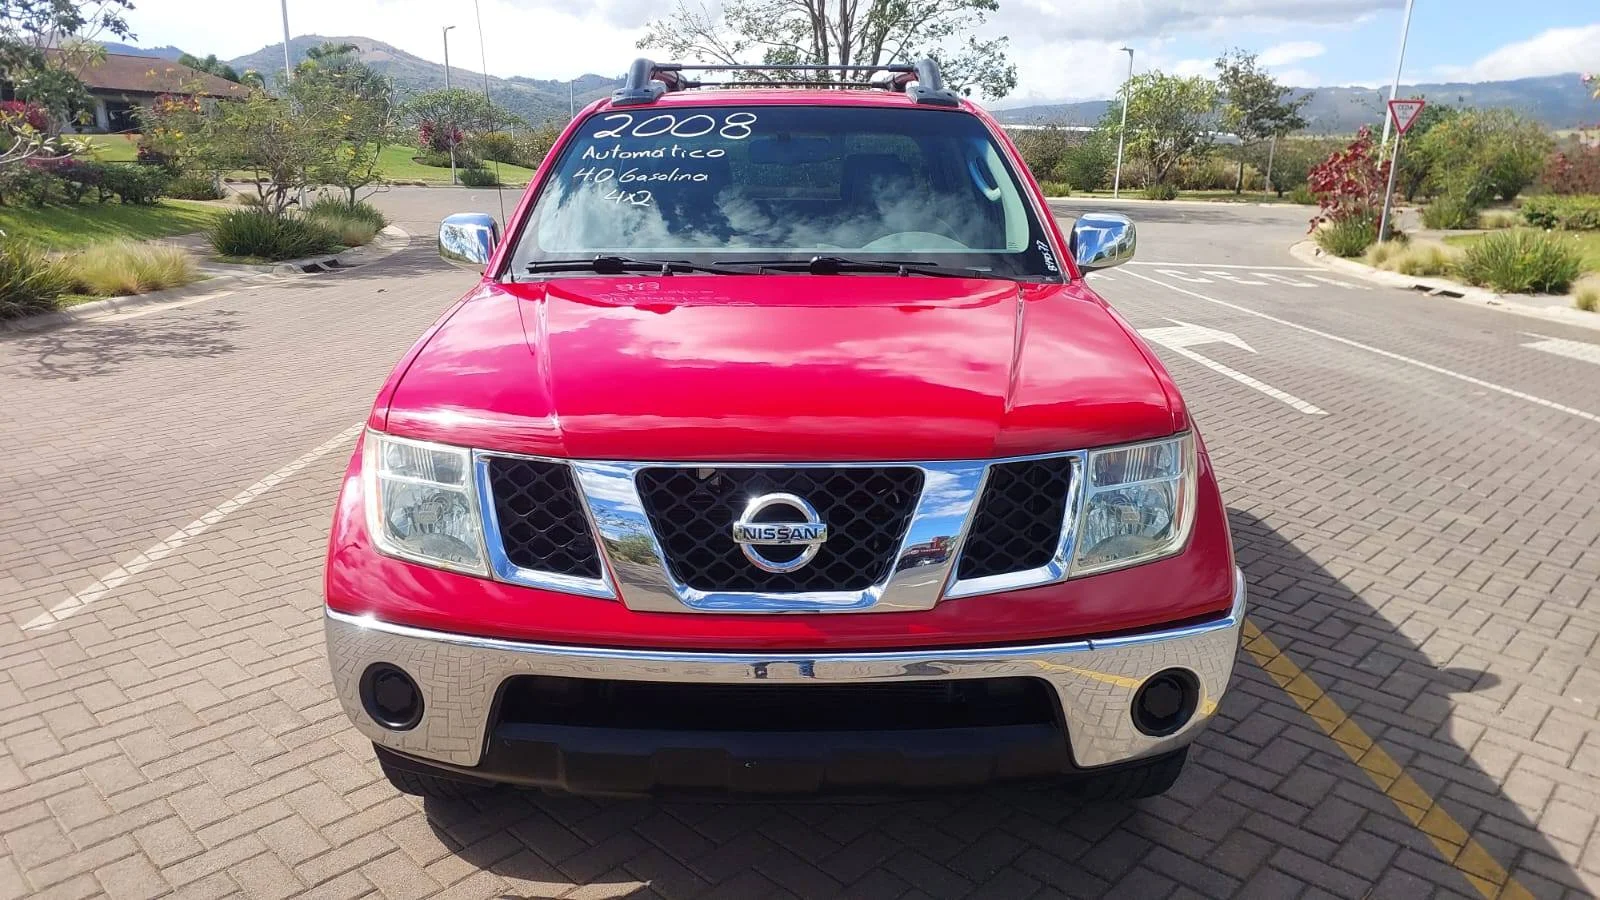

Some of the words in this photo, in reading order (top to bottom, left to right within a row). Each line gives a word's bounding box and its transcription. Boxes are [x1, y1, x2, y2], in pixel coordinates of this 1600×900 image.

[593, 112, 757, 139] 2008
[582, 144, 725, 160] Automático
[618, 168, 709, 183] Gasolina
[603, 190, 652, 207] 4x2
[743, 527, 818, 540] NISSAN
